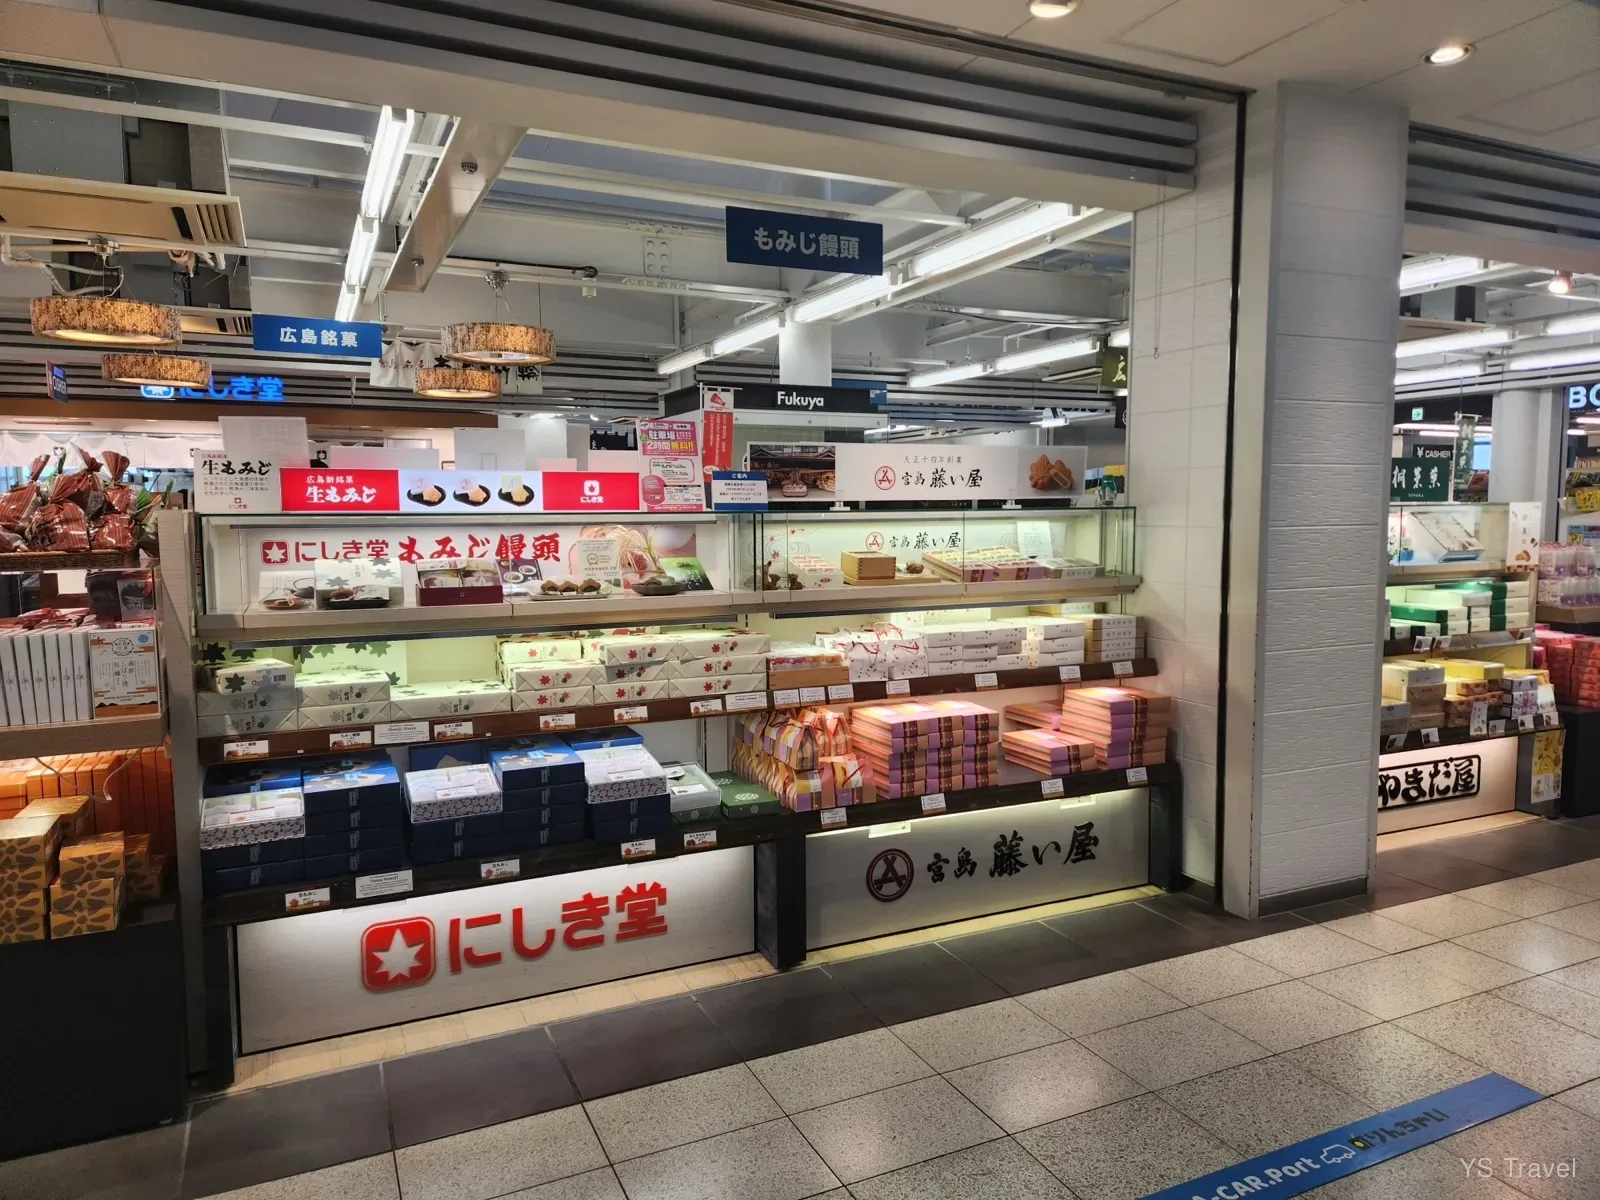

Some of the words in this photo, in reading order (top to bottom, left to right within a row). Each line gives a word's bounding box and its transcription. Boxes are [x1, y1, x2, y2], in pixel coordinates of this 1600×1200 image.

[754, 225, 860, 260] もみじ饅頭
[279, 325, 358, 349] 広島銘菓
[776, 390, 824, 410] Fukuya
[903, 455, 963, 465] 大正十四年創業
[1425, 450, 1451, 458] CASHIER
[201, 460, 272, 476] 生もみじ
[305, 475, 354, 484] 広島新銘菓
[305, 486, 377, 503] 生もみじ
[294, 538, 389, 563] にしき堂
[397, 532, 561, 565] もみじ饅頭
[1379, 757, 1476, 806] やまだ屋
[447, 880, 669, 974] にしき堂
